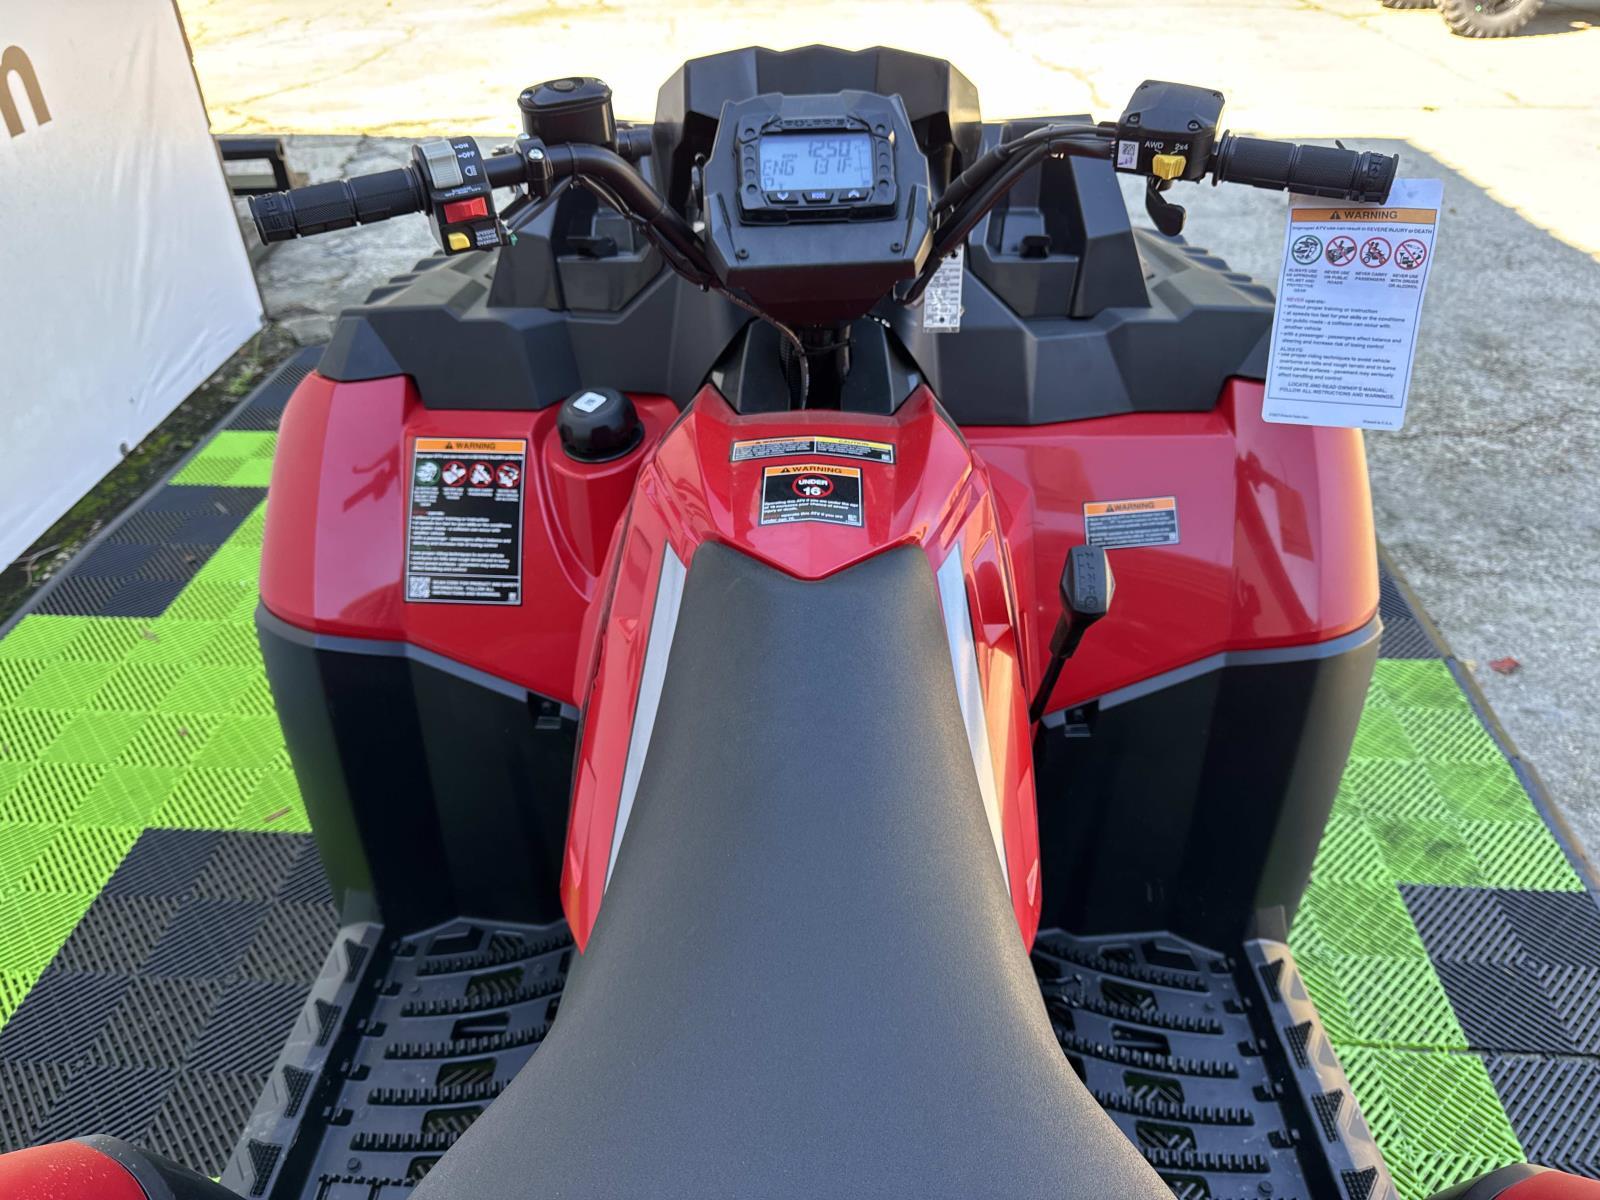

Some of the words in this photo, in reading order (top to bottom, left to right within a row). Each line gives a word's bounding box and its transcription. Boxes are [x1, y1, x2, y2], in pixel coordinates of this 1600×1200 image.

[808, 139, 851, 158] 1250
[1144, 140, 1164, 149] AWD
[762, 159, 795, 176] ENG
[1344, 210, 1398, 220] WARNING
[455, 442, 496, 451] WARNING
[792, 465, 843, 475] WARNING
[798, 479, 829, 487] UNDER
[803, 486, 822, 496] 16
[1113, 502, 1155, 511] WARNING
